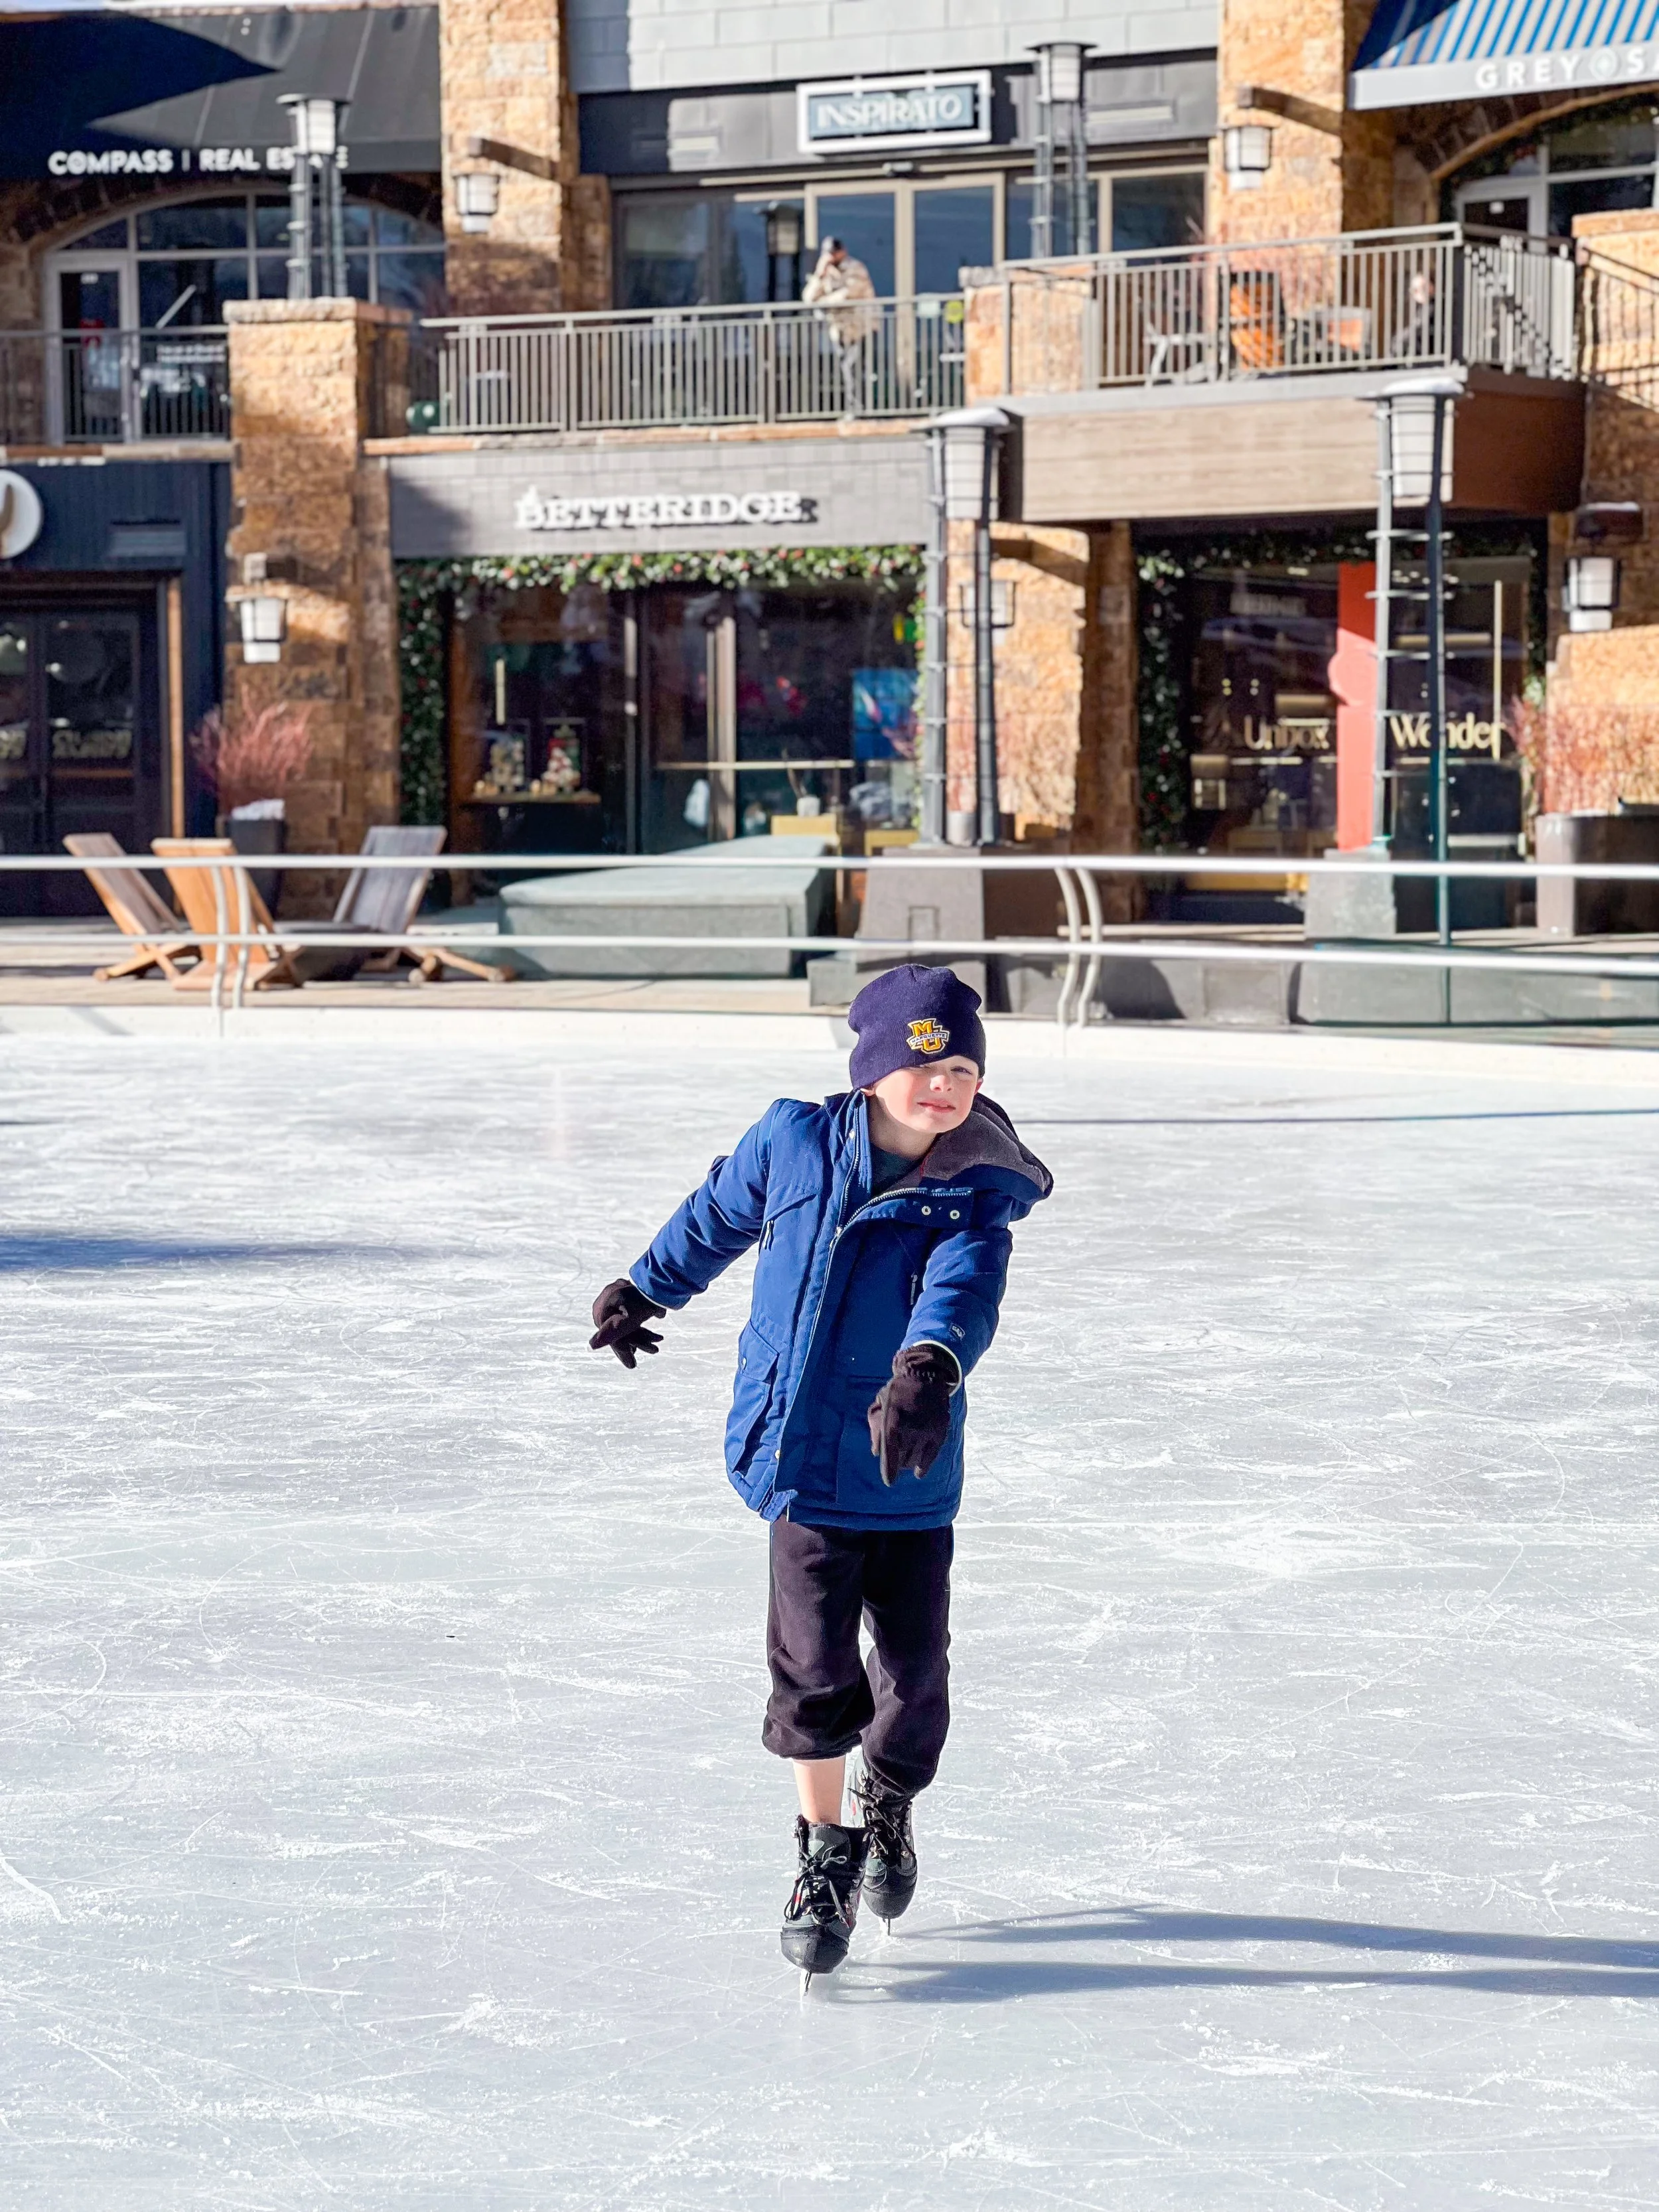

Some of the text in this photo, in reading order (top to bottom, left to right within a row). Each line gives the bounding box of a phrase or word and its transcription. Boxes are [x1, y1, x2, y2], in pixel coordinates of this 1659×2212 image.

[1475, 54, 1581, 90] GREY
[817, 93, 962, 129] INSPIRATO
[47, 149, 175, 175] COMPASS
[199, 147, 261, 171] REAL
[514, 484, 802, 530] BETTERIDGE
[911, 1033, 946, 1043] MARQUETTE
